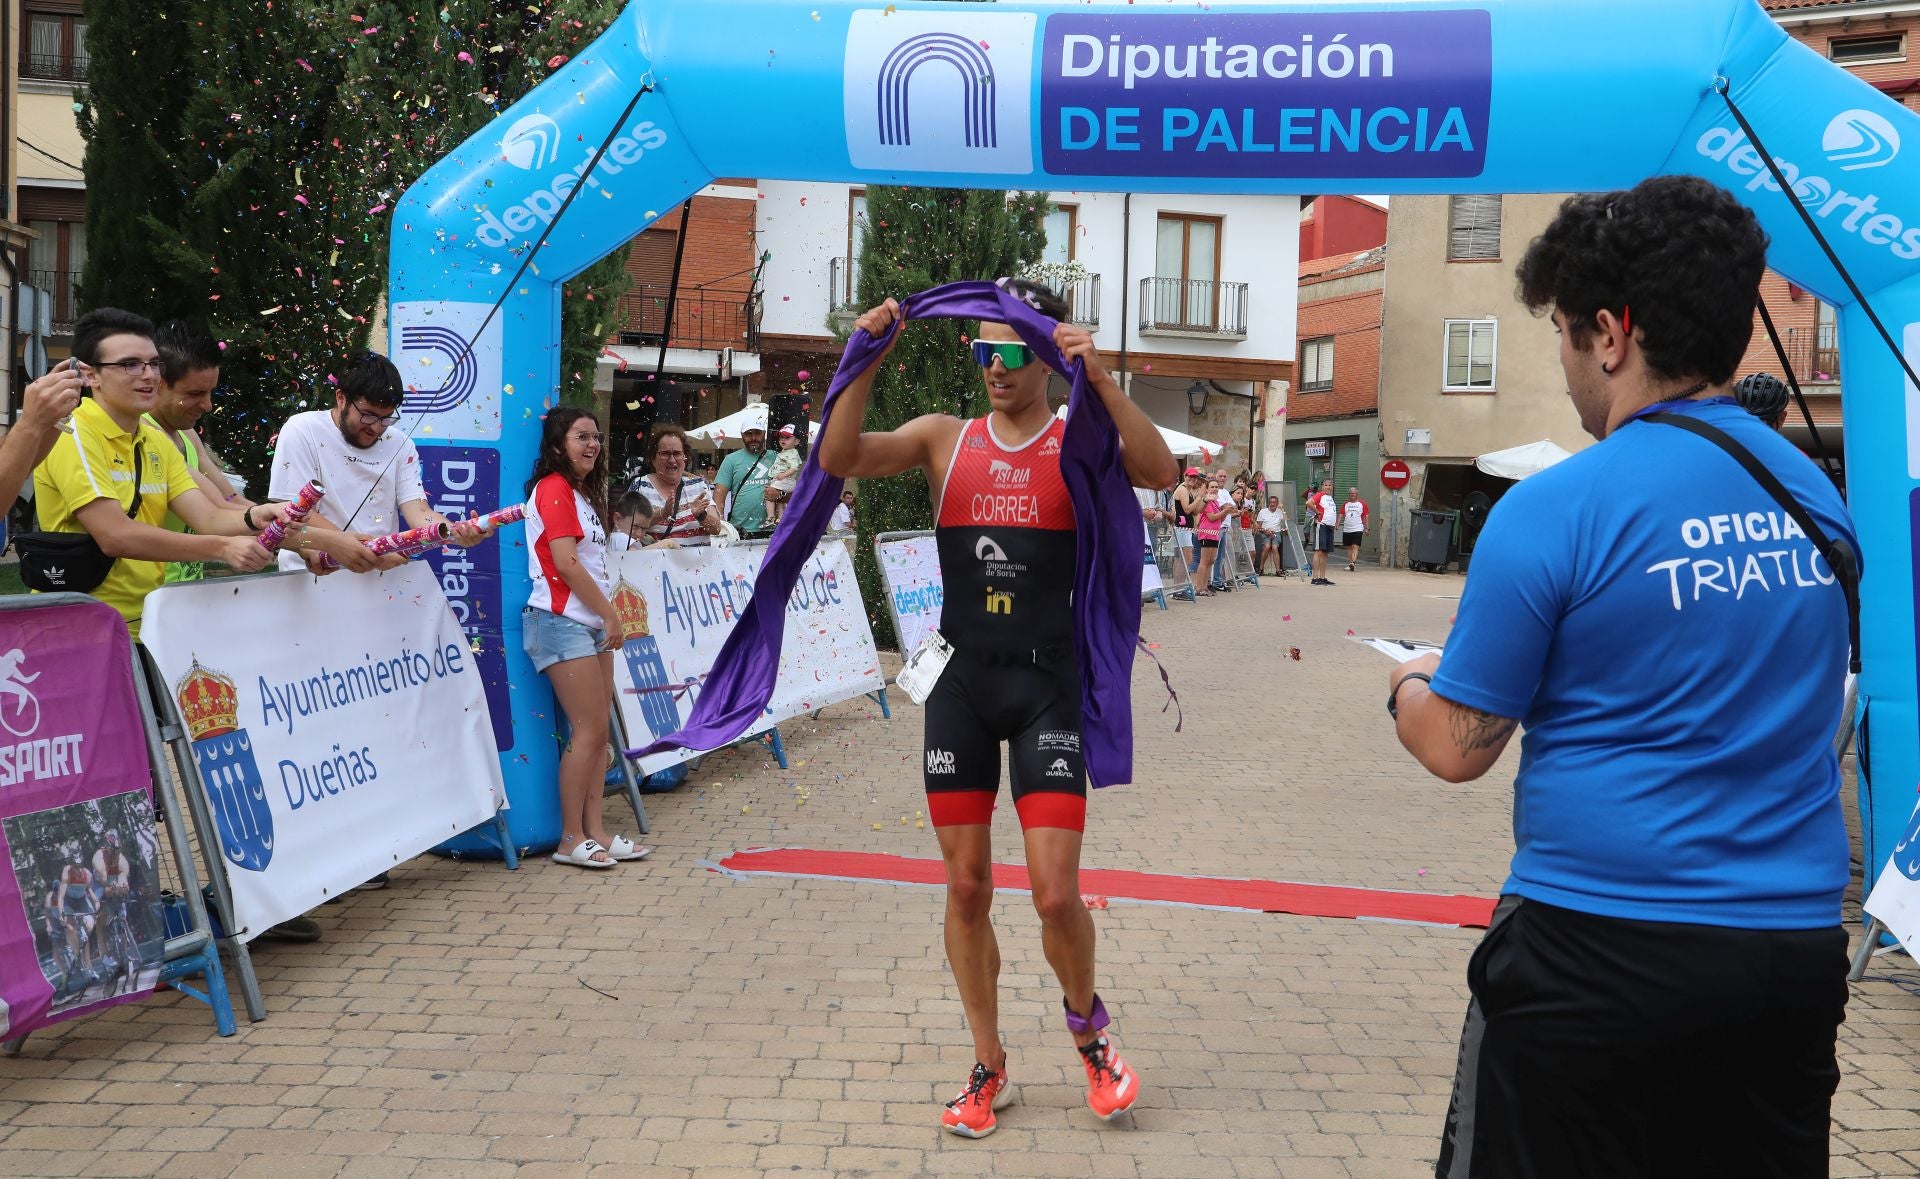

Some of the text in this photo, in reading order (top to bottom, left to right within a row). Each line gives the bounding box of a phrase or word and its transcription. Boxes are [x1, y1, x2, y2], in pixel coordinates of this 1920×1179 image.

[1060, 32, 1394, 89] Diputación
[1060, 106, 1475, 153] DE PALENCIA
[475, 121, 668, 248] deportes
[1696, 127, 1920, 260] deportes
[971, 493, 1039, 524] CORREA
[1681, 512, 1808, 549] OFICIA
[986, 562, 1027, 571] Diputación
[996, 570, 1016, 578] Soria
[1646, 546, 1837, 611] TRIATLÓ
[258, 634, 464, 736] Ayuntamiento de
[278, 743, 378, 811] Dueñas
[927, 748, 955, 765] MAD
